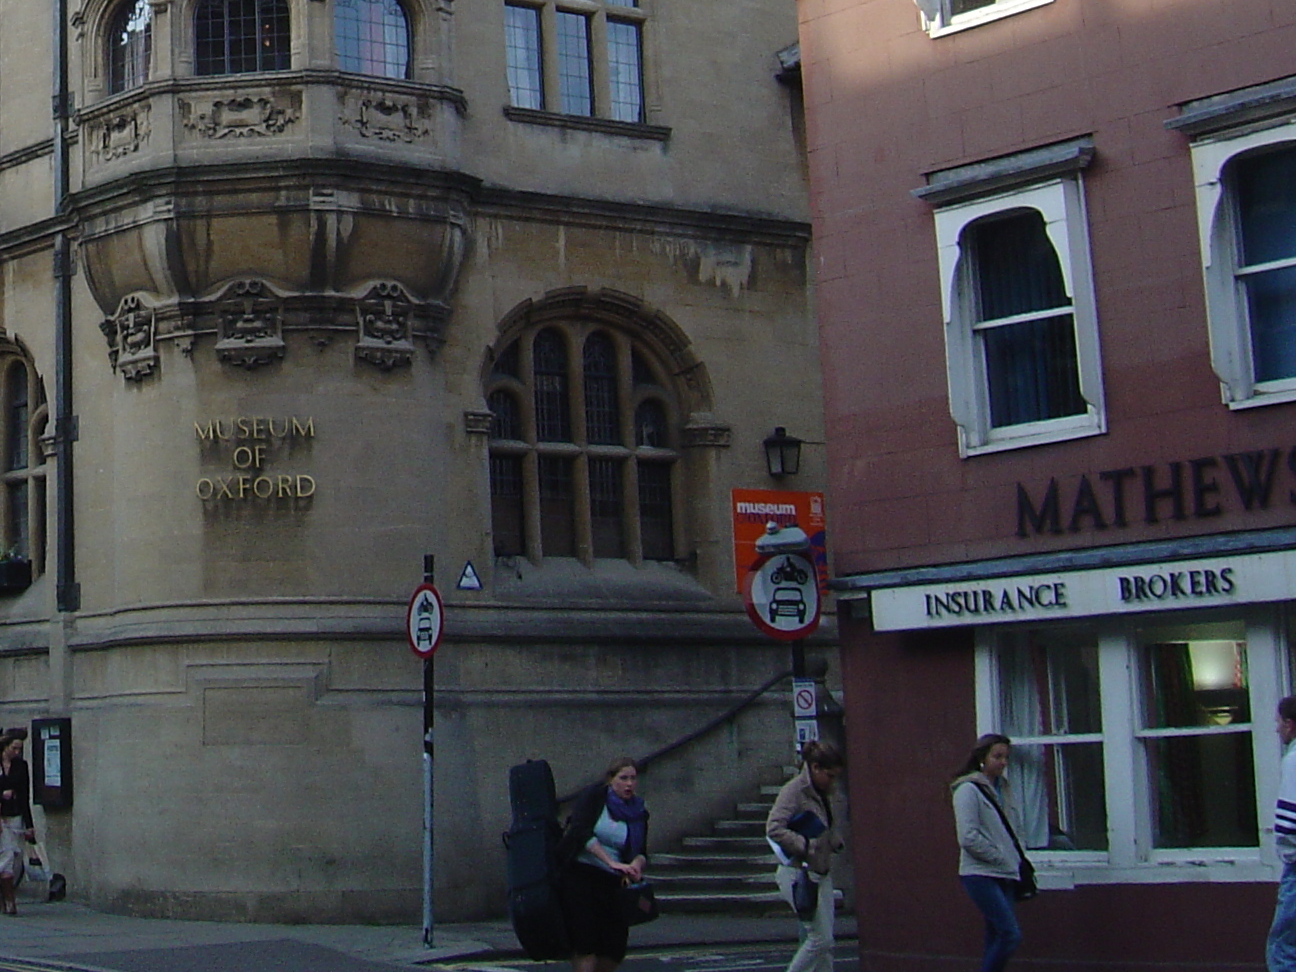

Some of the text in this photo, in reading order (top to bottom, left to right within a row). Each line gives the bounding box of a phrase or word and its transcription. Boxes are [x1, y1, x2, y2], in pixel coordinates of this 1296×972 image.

[193, 415, 315, 440] MUSEUM
[233, 445, 267, 468] OF
[196, 474, 316, 500] OXFORD
[736, 502, 796, 515] museum
[924, 567, 1235, 618] INSURANCE BROKERS
